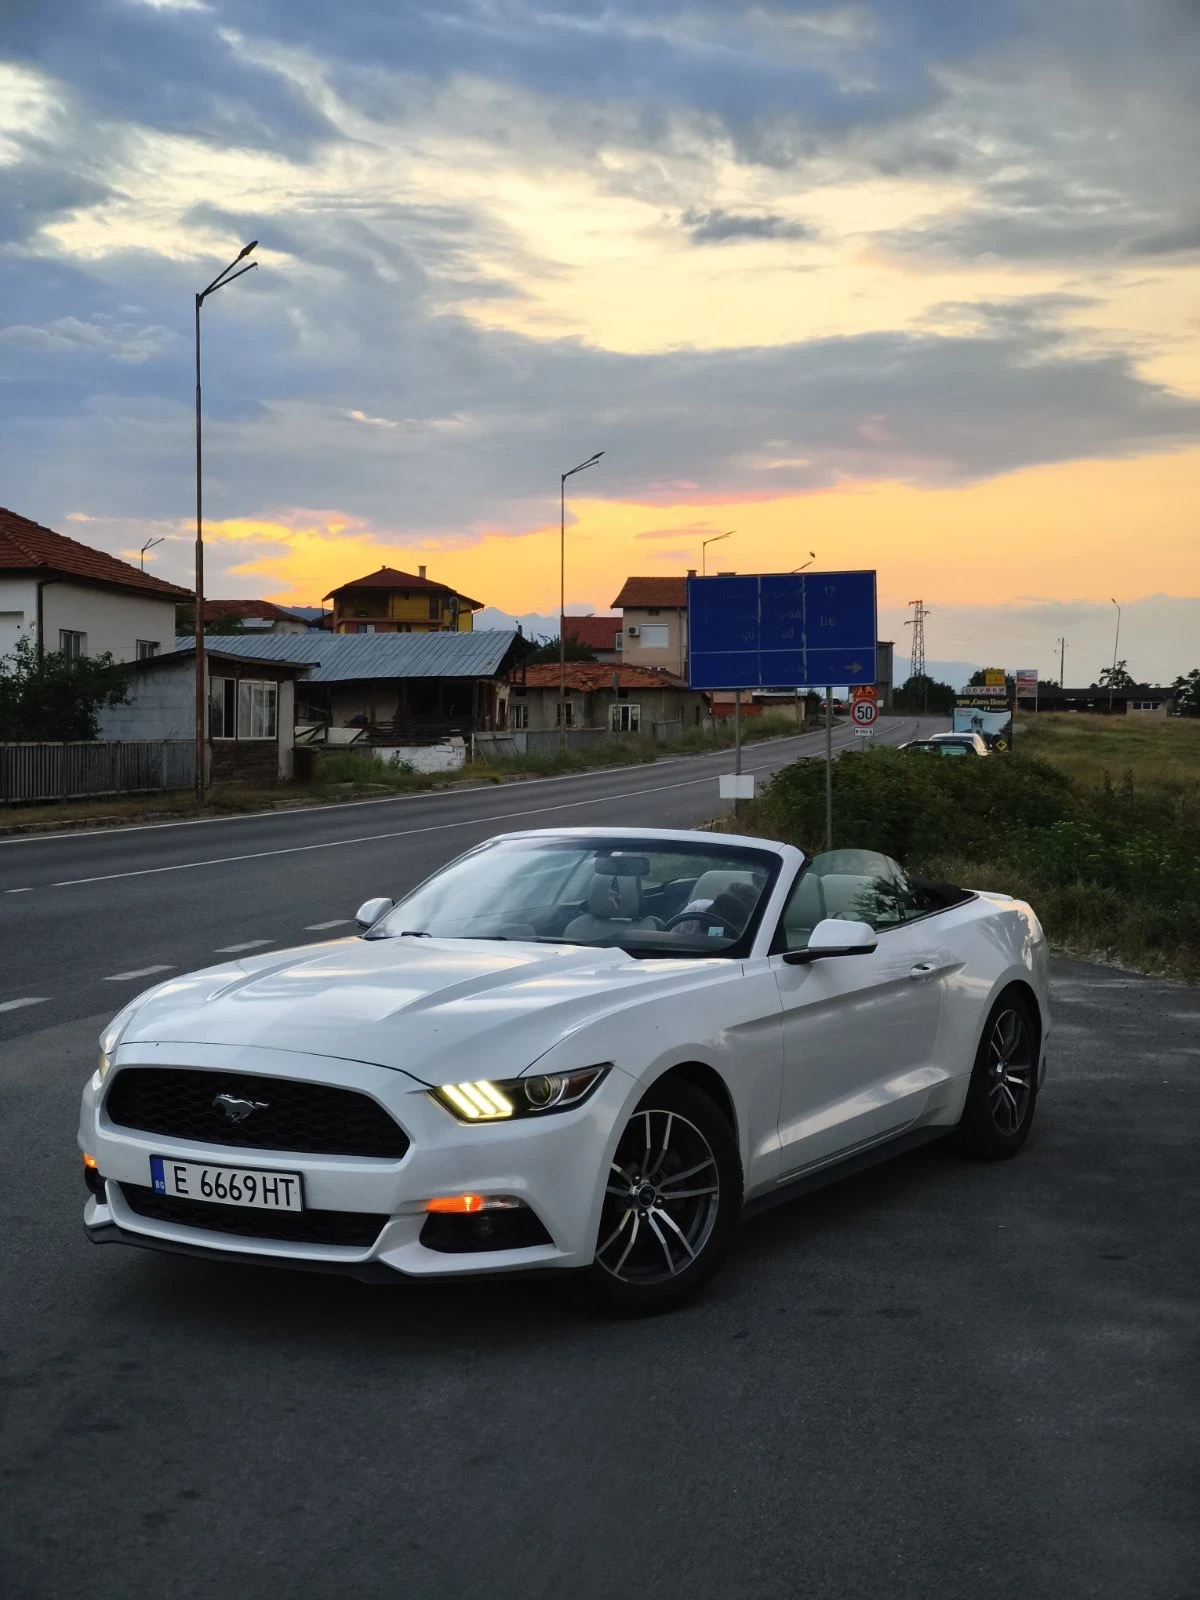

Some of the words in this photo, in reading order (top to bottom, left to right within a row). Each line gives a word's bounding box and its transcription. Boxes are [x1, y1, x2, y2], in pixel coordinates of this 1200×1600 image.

[857, 706, 873, 720] 50
[155, 1180, 165, 1189] BG
[173, 1165, 189, 1194] E
